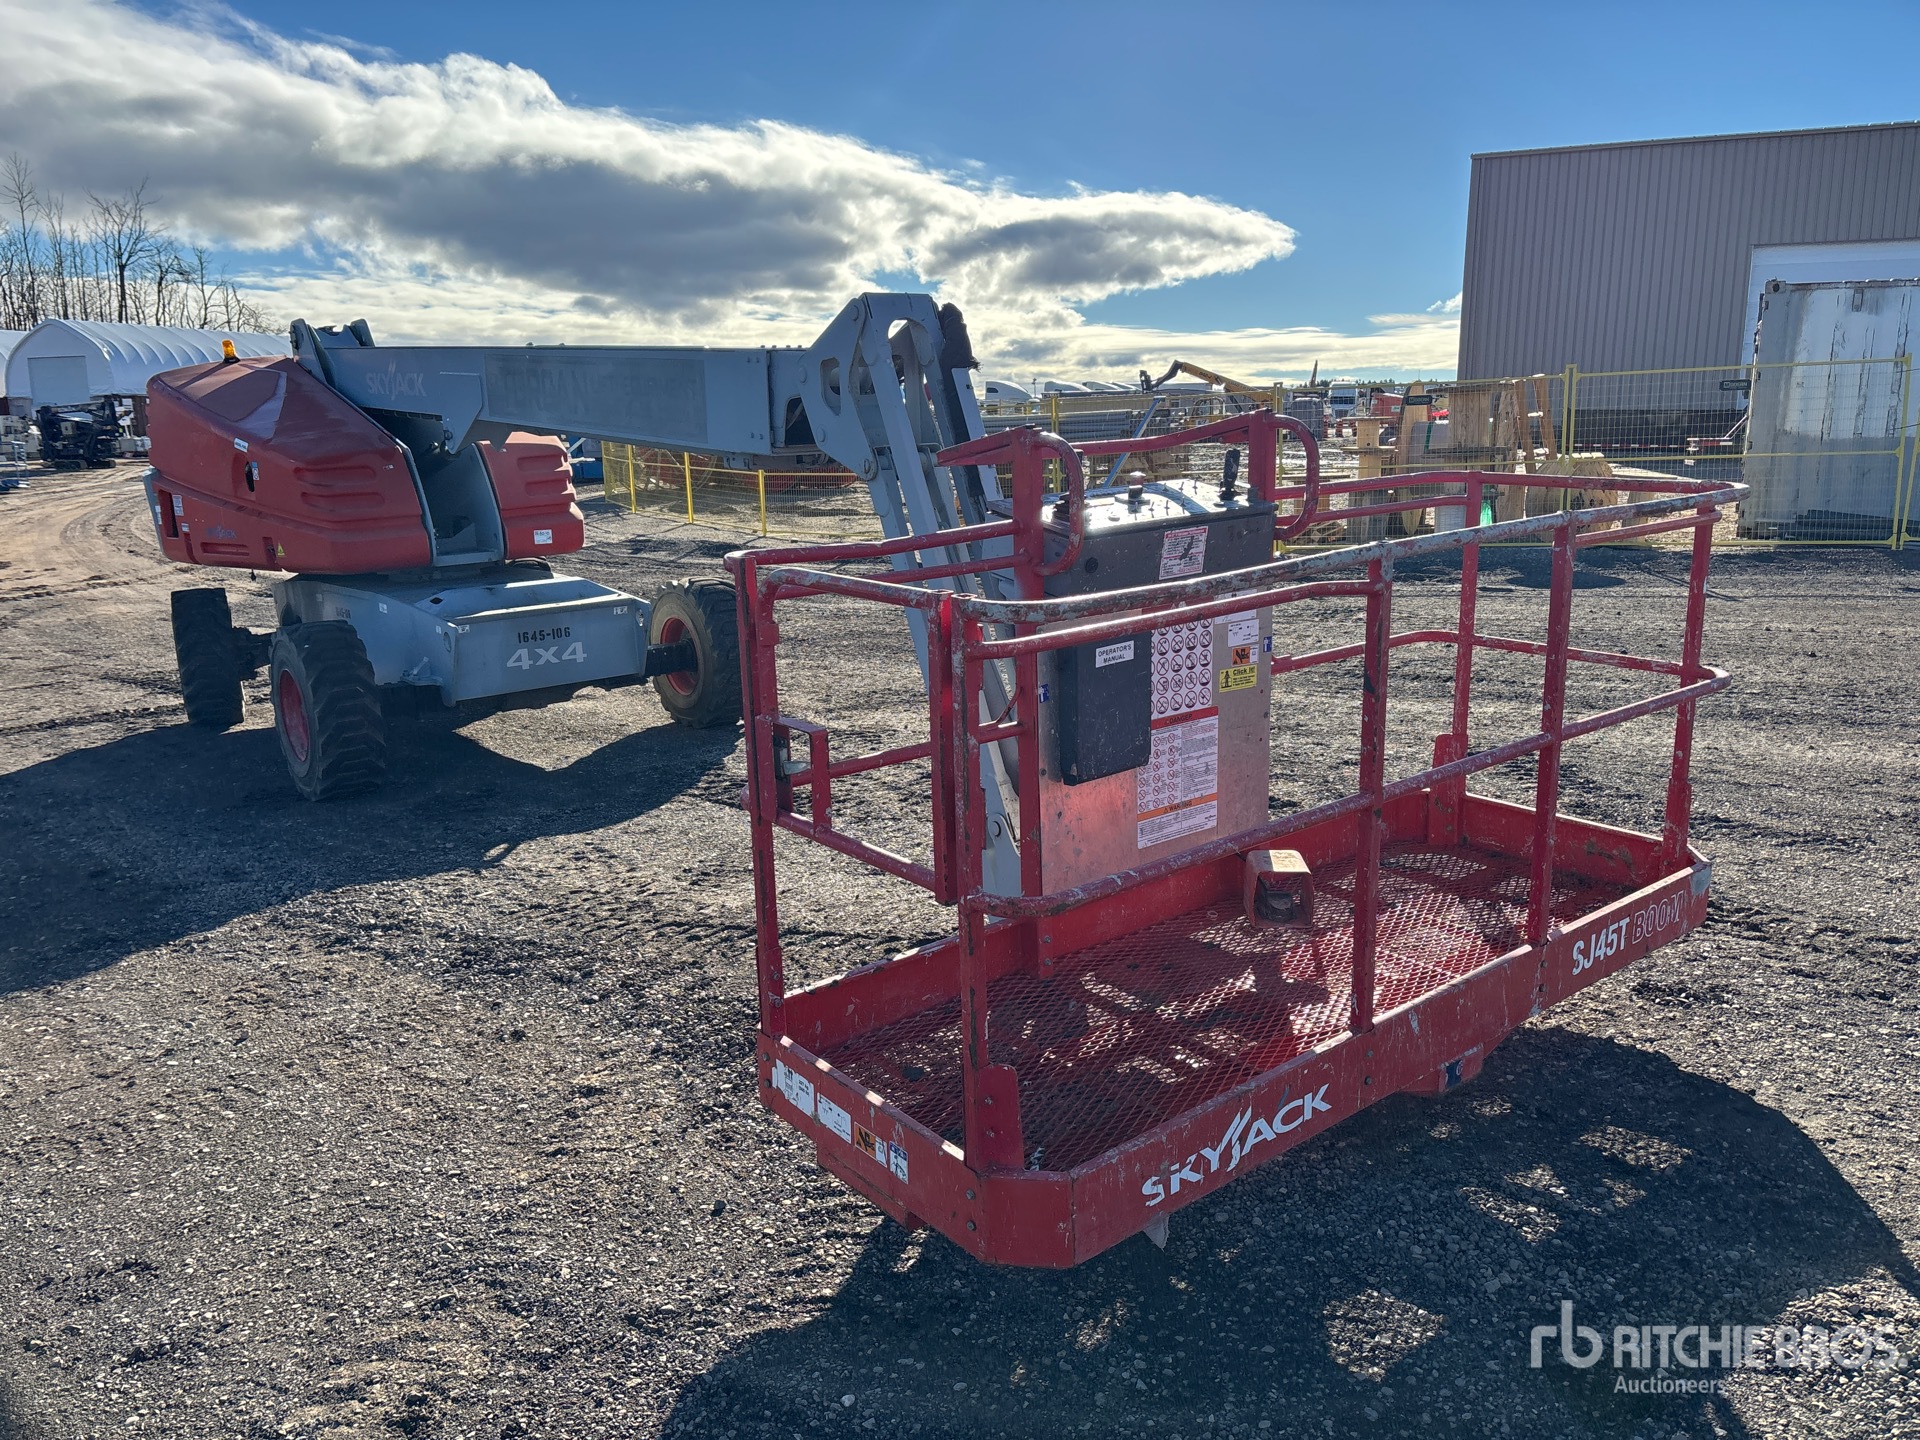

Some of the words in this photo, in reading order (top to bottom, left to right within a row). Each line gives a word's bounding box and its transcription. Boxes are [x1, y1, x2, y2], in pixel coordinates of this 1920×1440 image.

[366, 358, 427, 400] SKYJACK
[517, 626, 571, 644] 1645-106
[1103, 653, 1126, 664] MANUAL
[1169, 713, 1193, 725] DANGER
[1169, 800, 1193, 811] WARNG
[1571, 916, 1631, 976] SJ45T
[1141, 1083, 1333, 1207] SKYJACK
